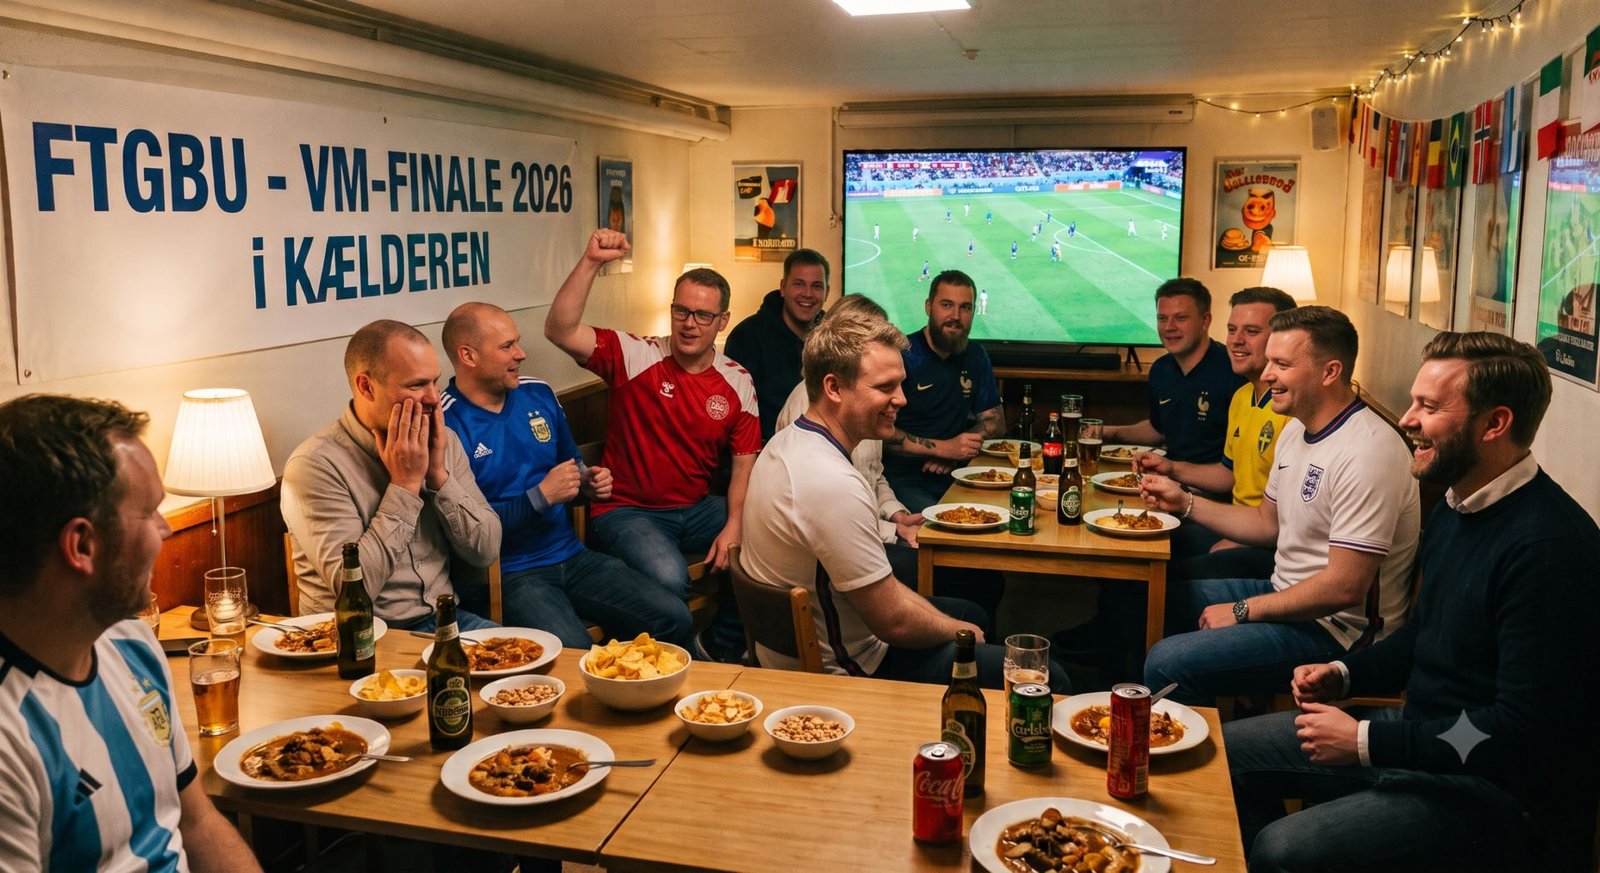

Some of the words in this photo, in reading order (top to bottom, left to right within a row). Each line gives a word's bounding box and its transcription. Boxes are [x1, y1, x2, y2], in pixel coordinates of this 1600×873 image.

[32, 121, 247, 213] FTGBU
[267, 175, 287, 190] -
[299, 143, 503, 212] VM-FINALE
[511, 161, 573, 213] 2026
[252, 237, 267, 309] i
[284, 231, 491, 306] KÆLDEREN
[1012, 717, 1051, 738] Carlsb
